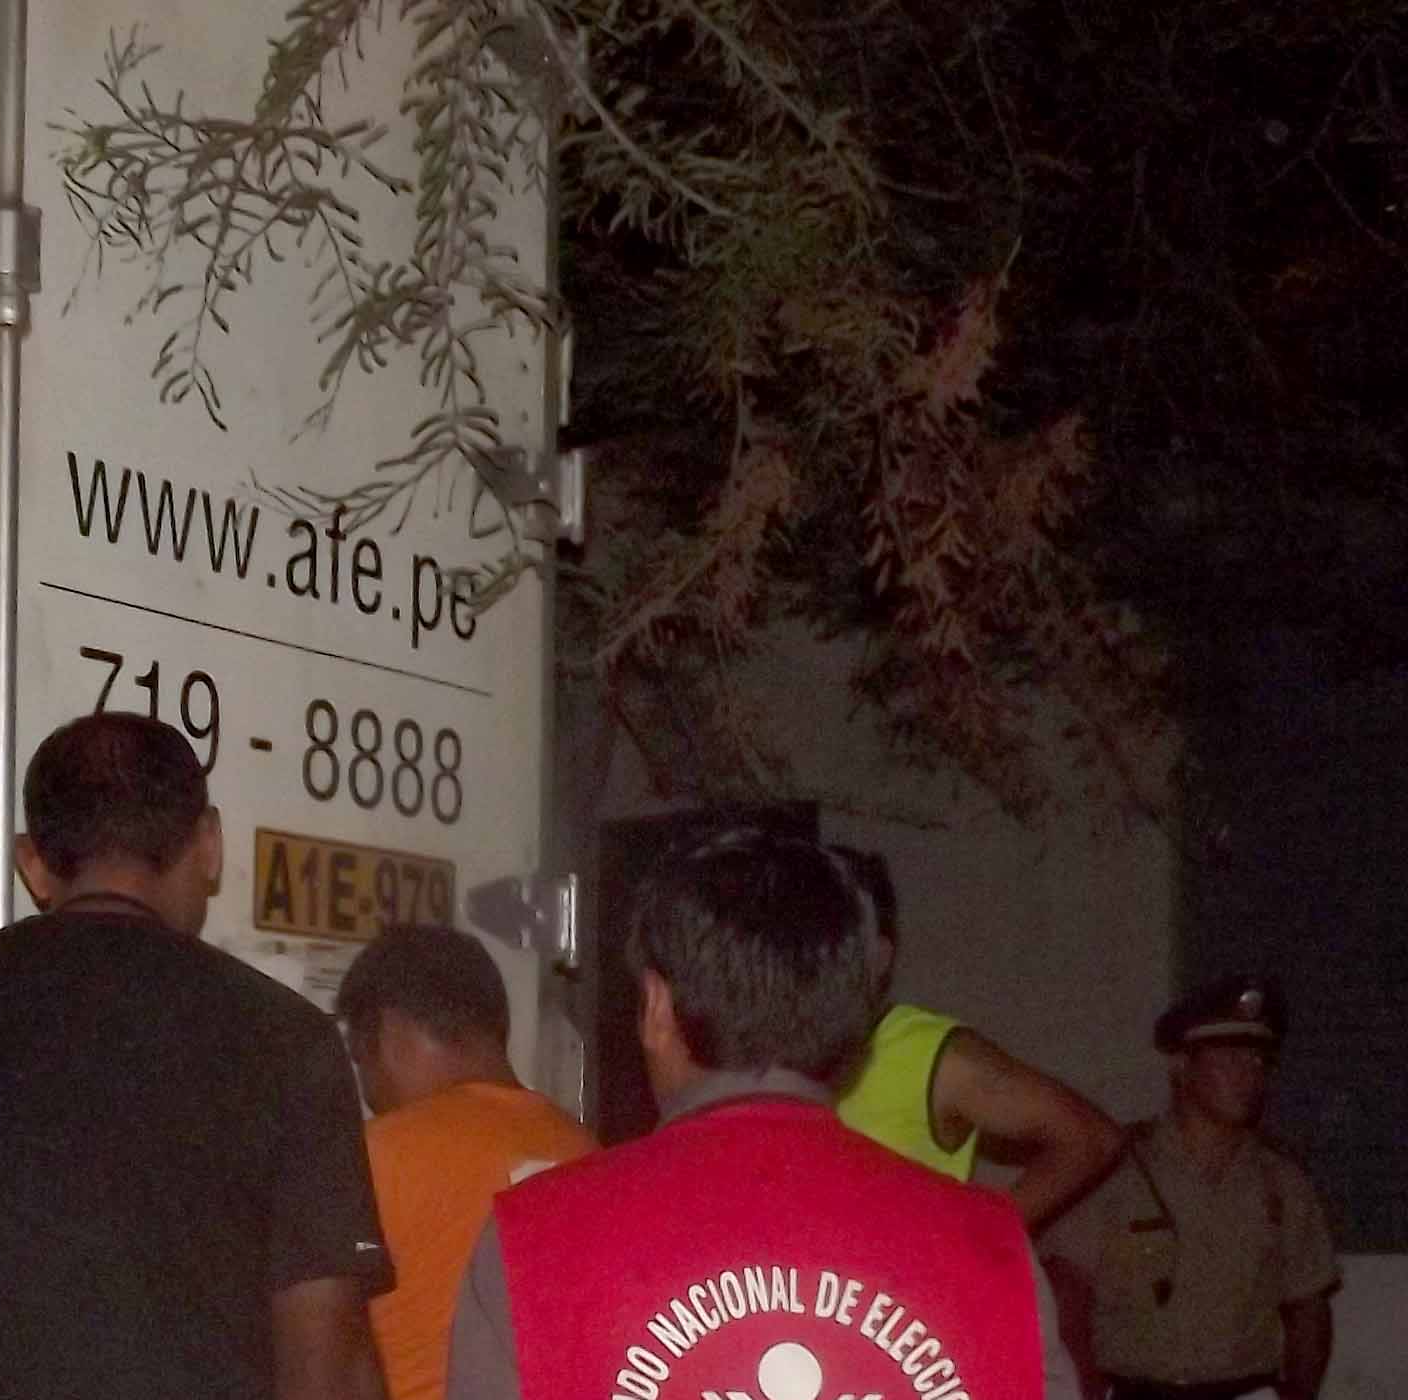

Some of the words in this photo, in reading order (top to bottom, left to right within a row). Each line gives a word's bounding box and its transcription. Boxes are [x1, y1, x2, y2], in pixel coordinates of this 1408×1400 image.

[66, 451, 478, 649] www.afe.pe
[302, 698, 464, 825] 8888
[647, 1265, 805, 1358] NACIONAL
[815, 1271, 864, 1326] DE
